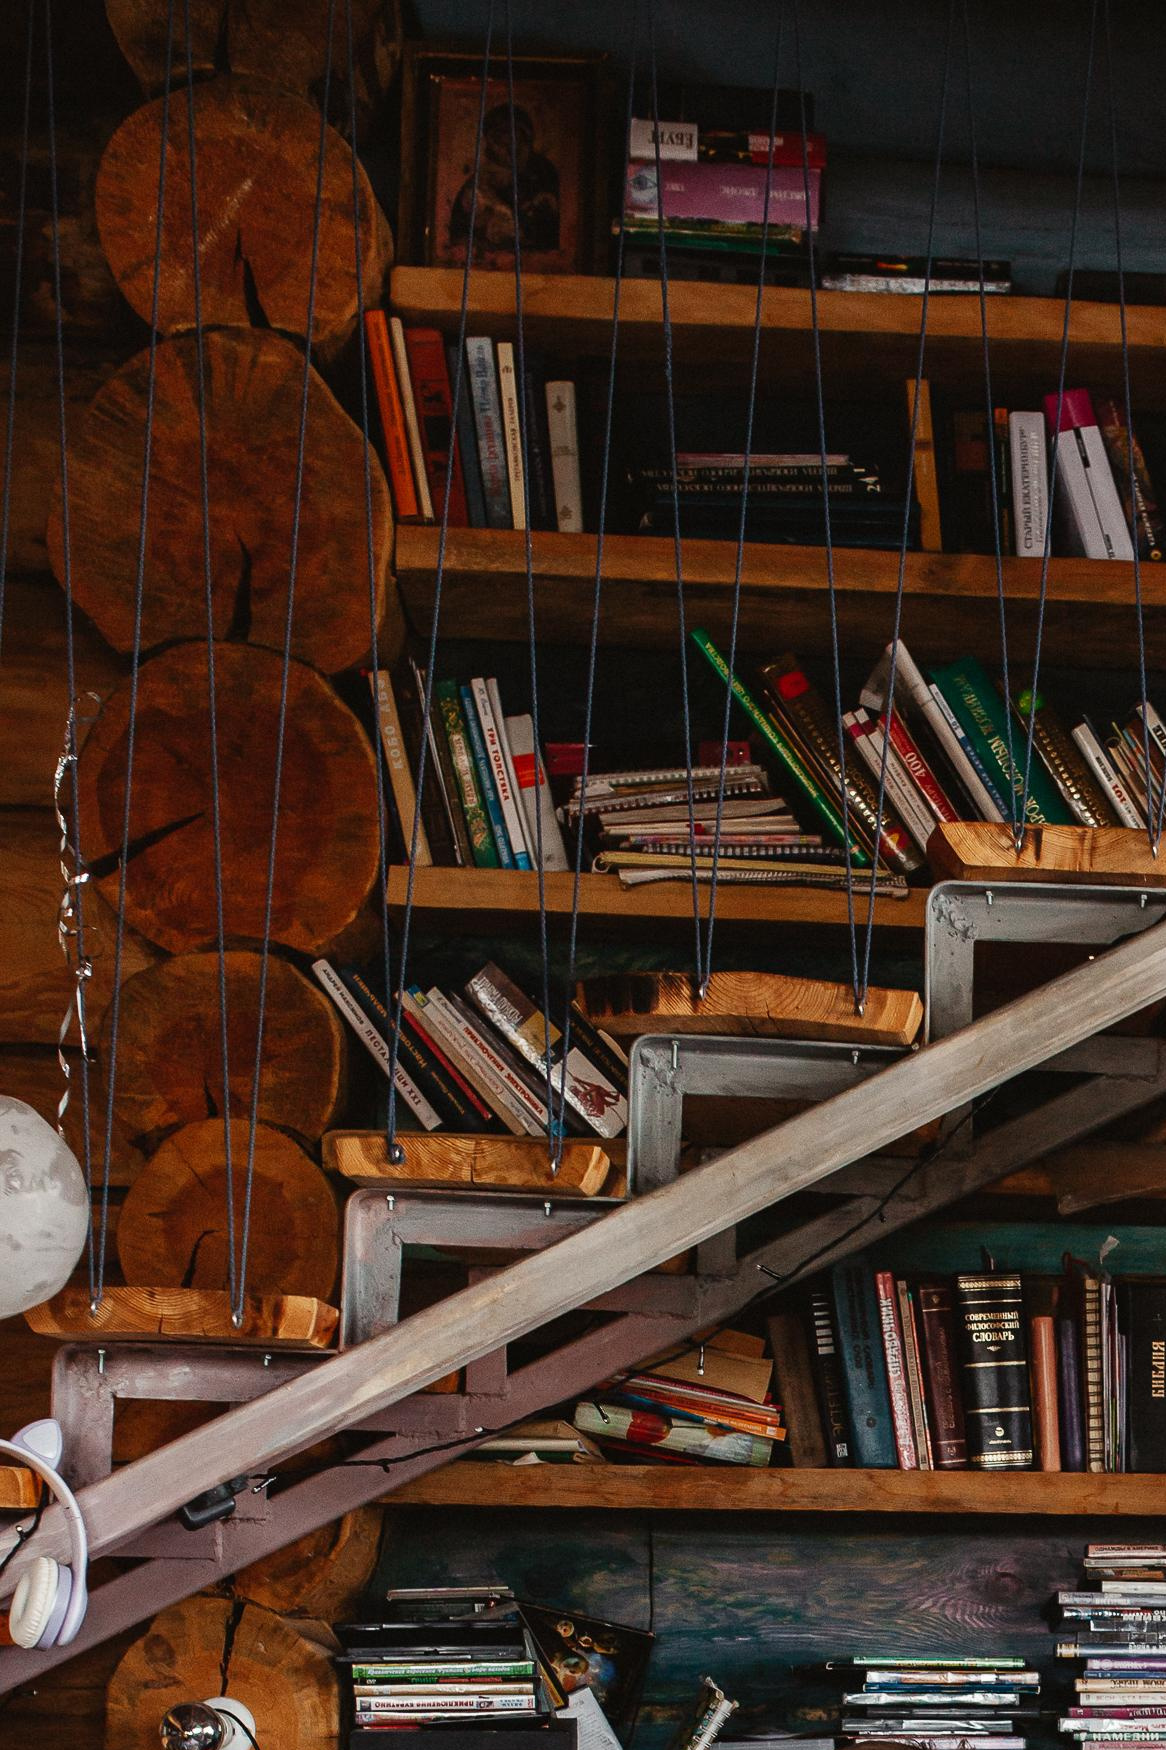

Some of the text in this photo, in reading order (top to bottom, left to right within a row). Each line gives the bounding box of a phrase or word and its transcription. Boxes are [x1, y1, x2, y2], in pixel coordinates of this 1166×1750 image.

[1021, 507, 1033, 549] СТАРЫЙ
[486, 728, 497, 748] ТРИ
[903, 749, 927, 779] 400
[491, 749, 511, 802] ТОЛСТЯКА
[1111, 783, 1126, 803] 101
[965, 1311, 1019, 1321] СОВРЕМЕННЫЙ
[965, 1321, 1020, 1331] ФИЛОСОФСКИЙ
[879, 1297, 901, 1376] СПРАВОЧНИК
[973, 1331, 1015, 1342] СЛОВАРЬ
[1151, 1338, 1165, 1397] БИБЛИЯ
[373, 1699, 473, 1708] ПРИКЛЮЧЕНИЯ БУРАТИНО
[1092, 1731, 1159, 1741] НАМЕДНИ
